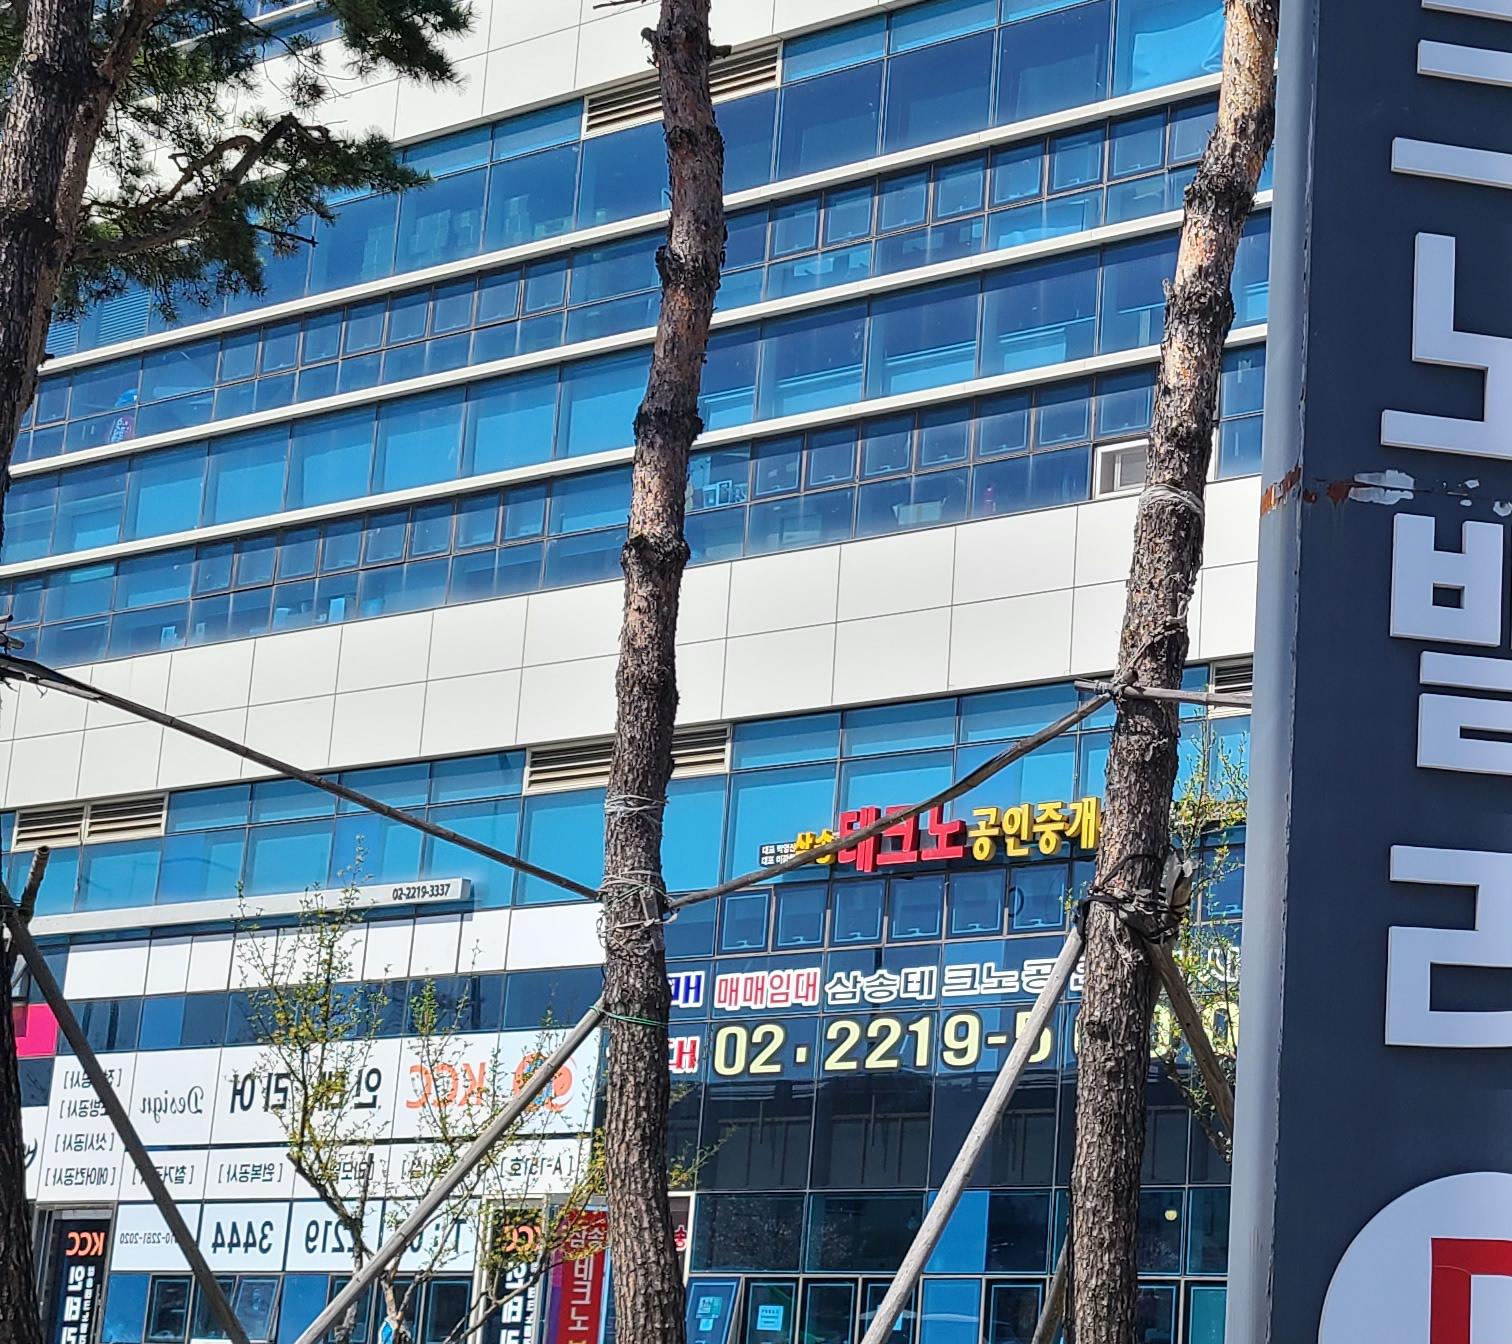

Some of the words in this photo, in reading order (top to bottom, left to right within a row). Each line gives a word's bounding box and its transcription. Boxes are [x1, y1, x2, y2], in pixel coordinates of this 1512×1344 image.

[968, 795, 1103, 862] 공인중개
[391, 883, 451, 901] 02-2219-3337
[667, 971, 705, 1008] 매
[715, 967, 820, 1010] 매매임대
[667, 1035, 700, 1073] 대
